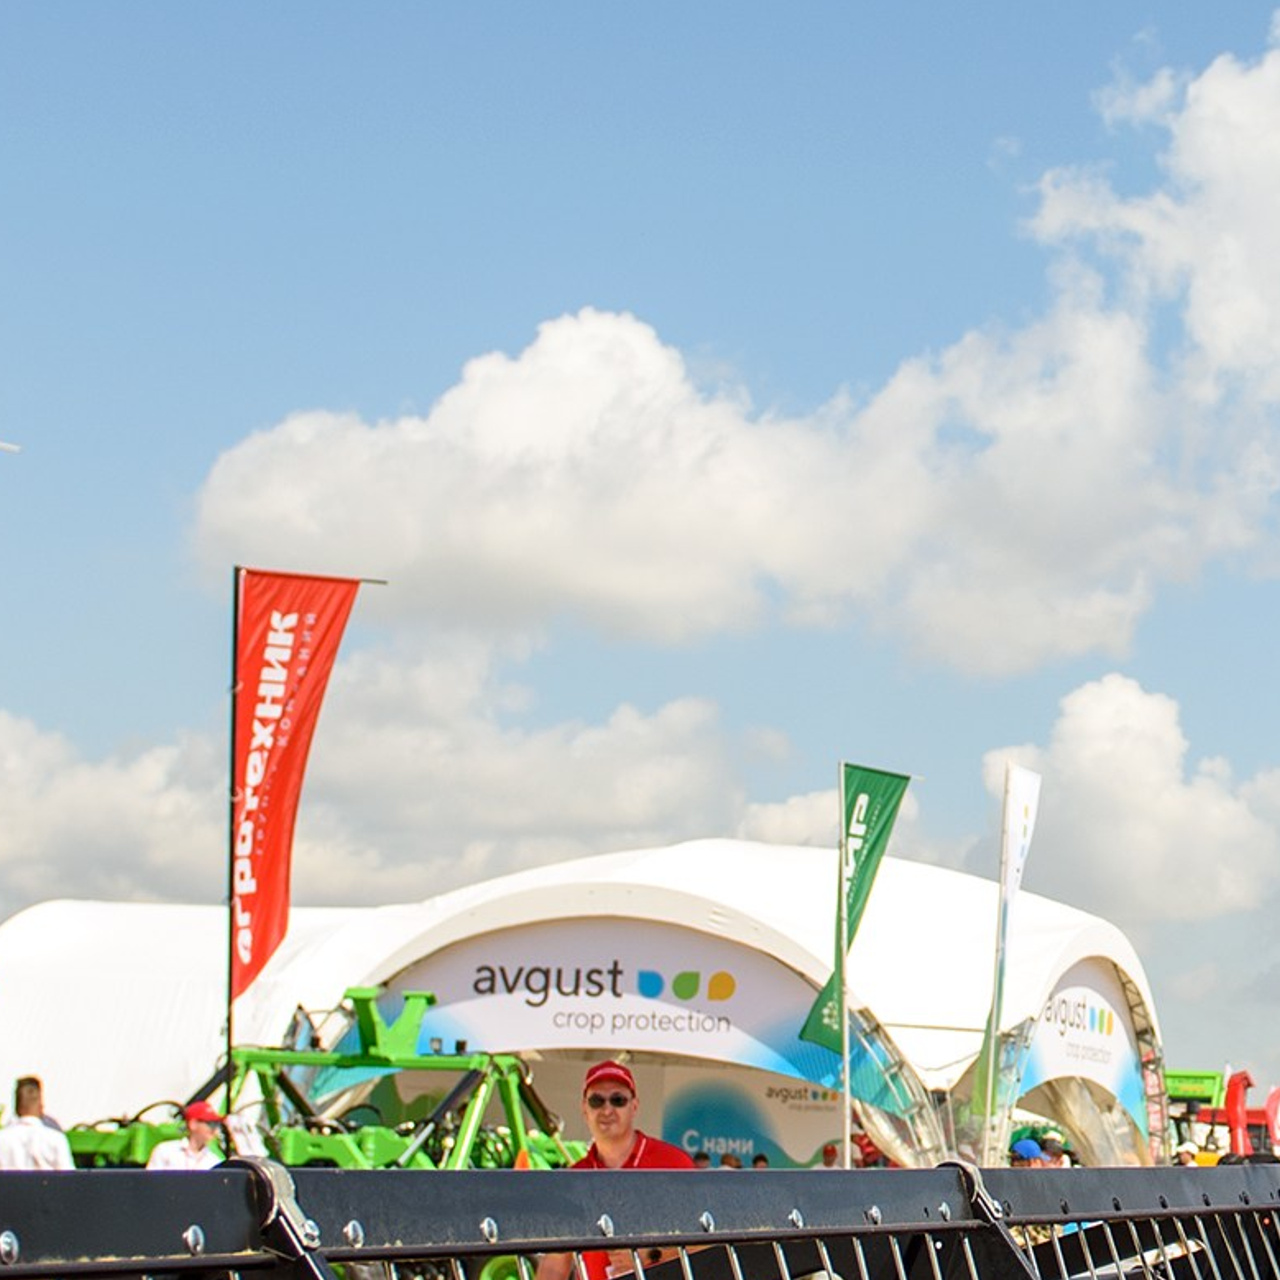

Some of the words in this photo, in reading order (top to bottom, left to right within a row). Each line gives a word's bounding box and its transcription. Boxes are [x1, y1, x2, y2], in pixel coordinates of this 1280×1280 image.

[473, 960, 624, 1008] avgust
[553, 1011, 605, 1034] crop
[611, 1010, 731, 1035] protection
